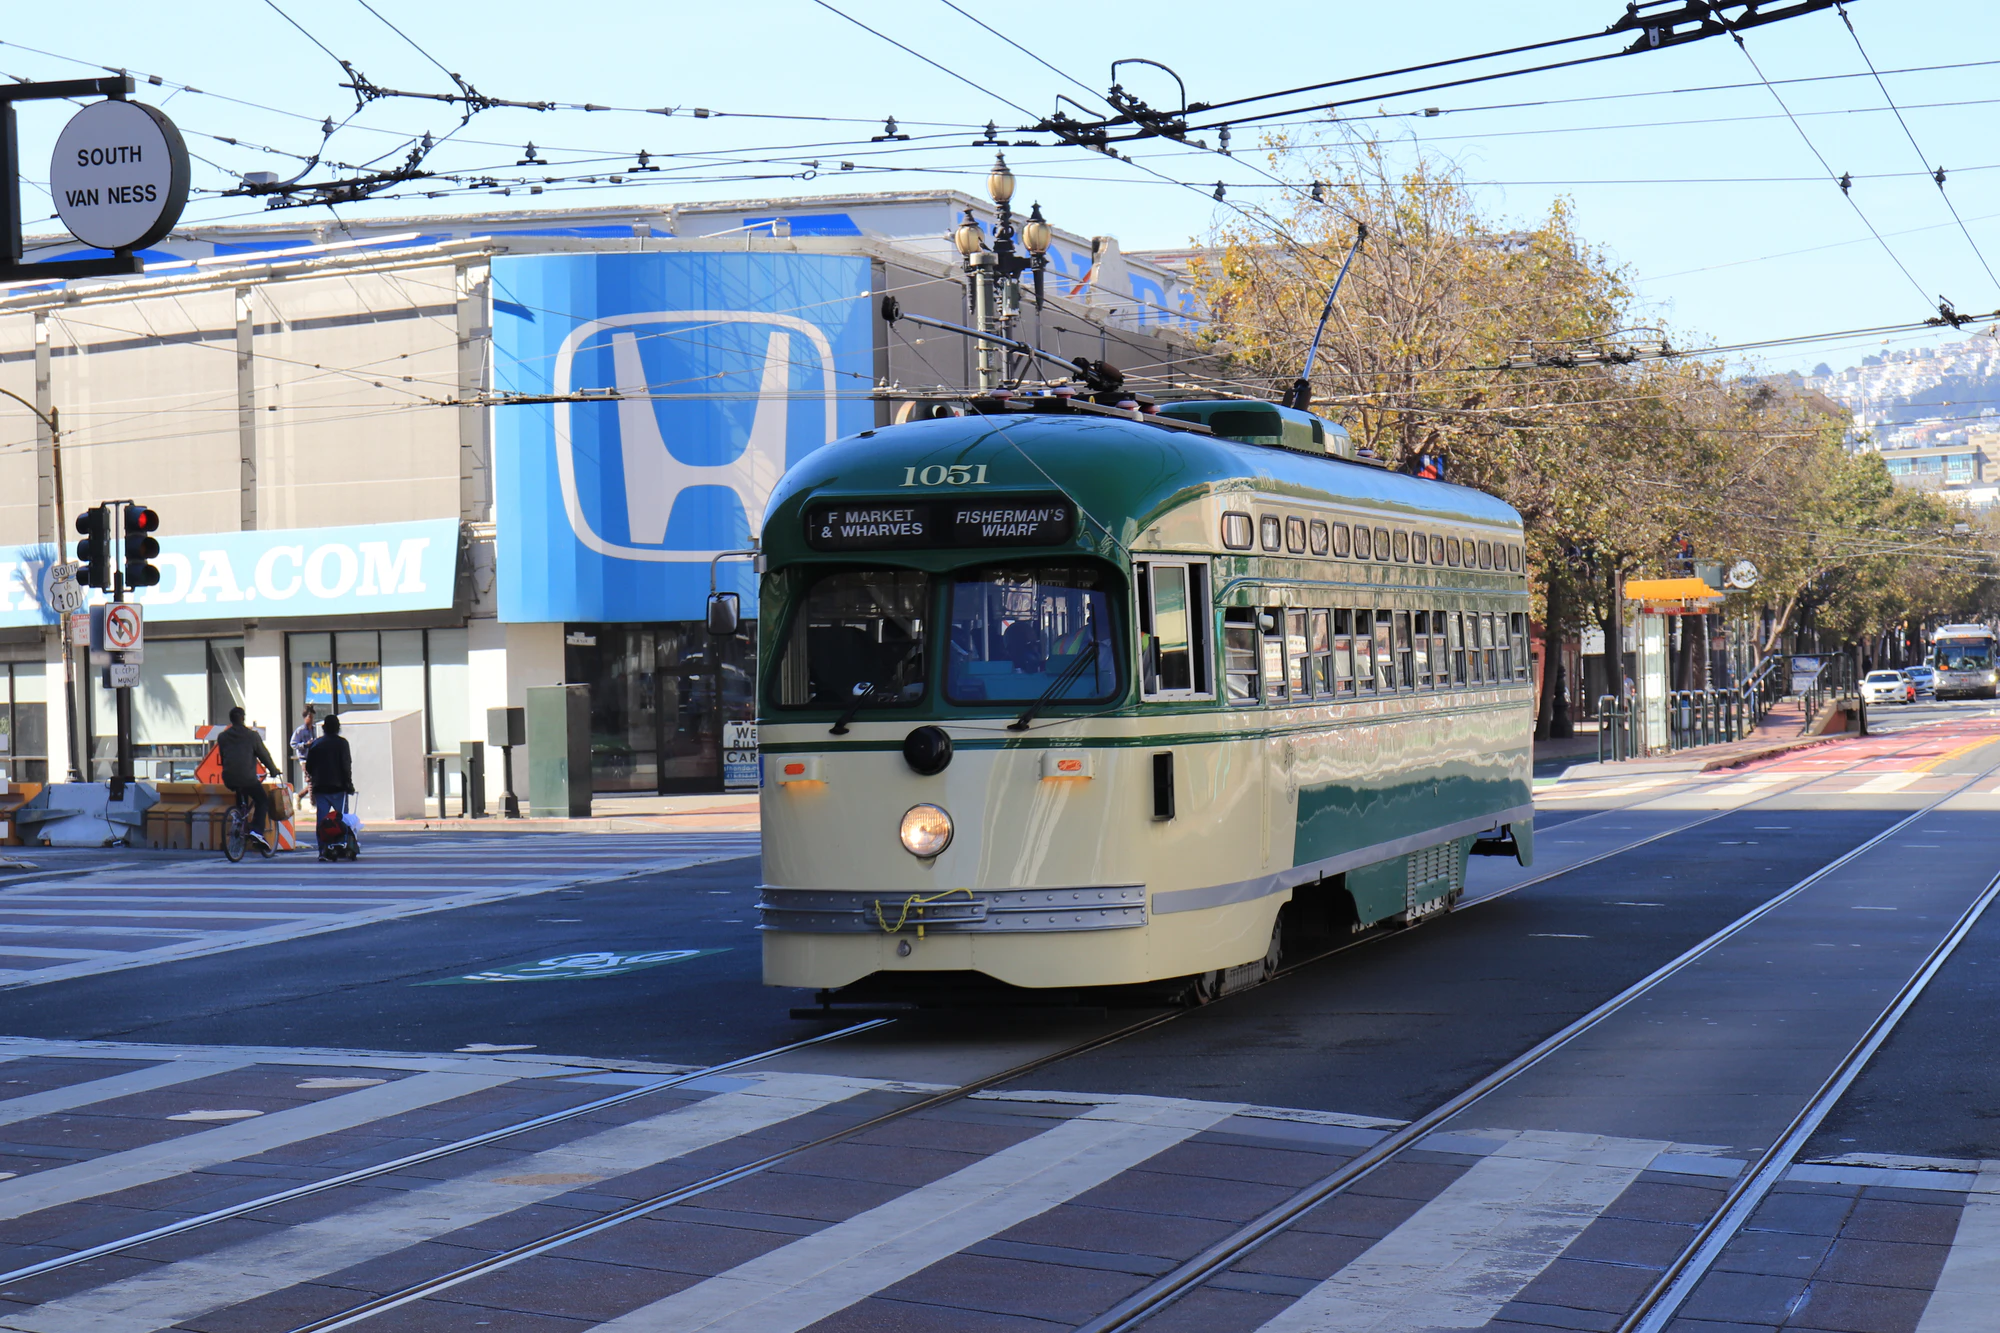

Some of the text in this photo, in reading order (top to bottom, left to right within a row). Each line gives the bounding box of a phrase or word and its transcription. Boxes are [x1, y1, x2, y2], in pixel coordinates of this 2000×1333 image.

[77, 145, 142, 167] SOUTH
[65, 184, 157, 207] VAN NESS
[898, 464, 990, 487] 1051
[828, 509, 915, 524] F MARKET
[956, 508, 1065, 524] FISHERMAN'S
[821, 522, 923, 538] & WHARVES
[981, 523, 1039, 537] WHARF
[0, 538, 430, 612] HDA.COM
[53, 563, 79, 577] SOUTH
[58, 591, 79, 610] 101
[114, 667, 136, 675] ECEPT
[310, 672, 342, 694] SAL
[736, 727, 757, 739] WE
[726, 751, 757, 763] CAR
